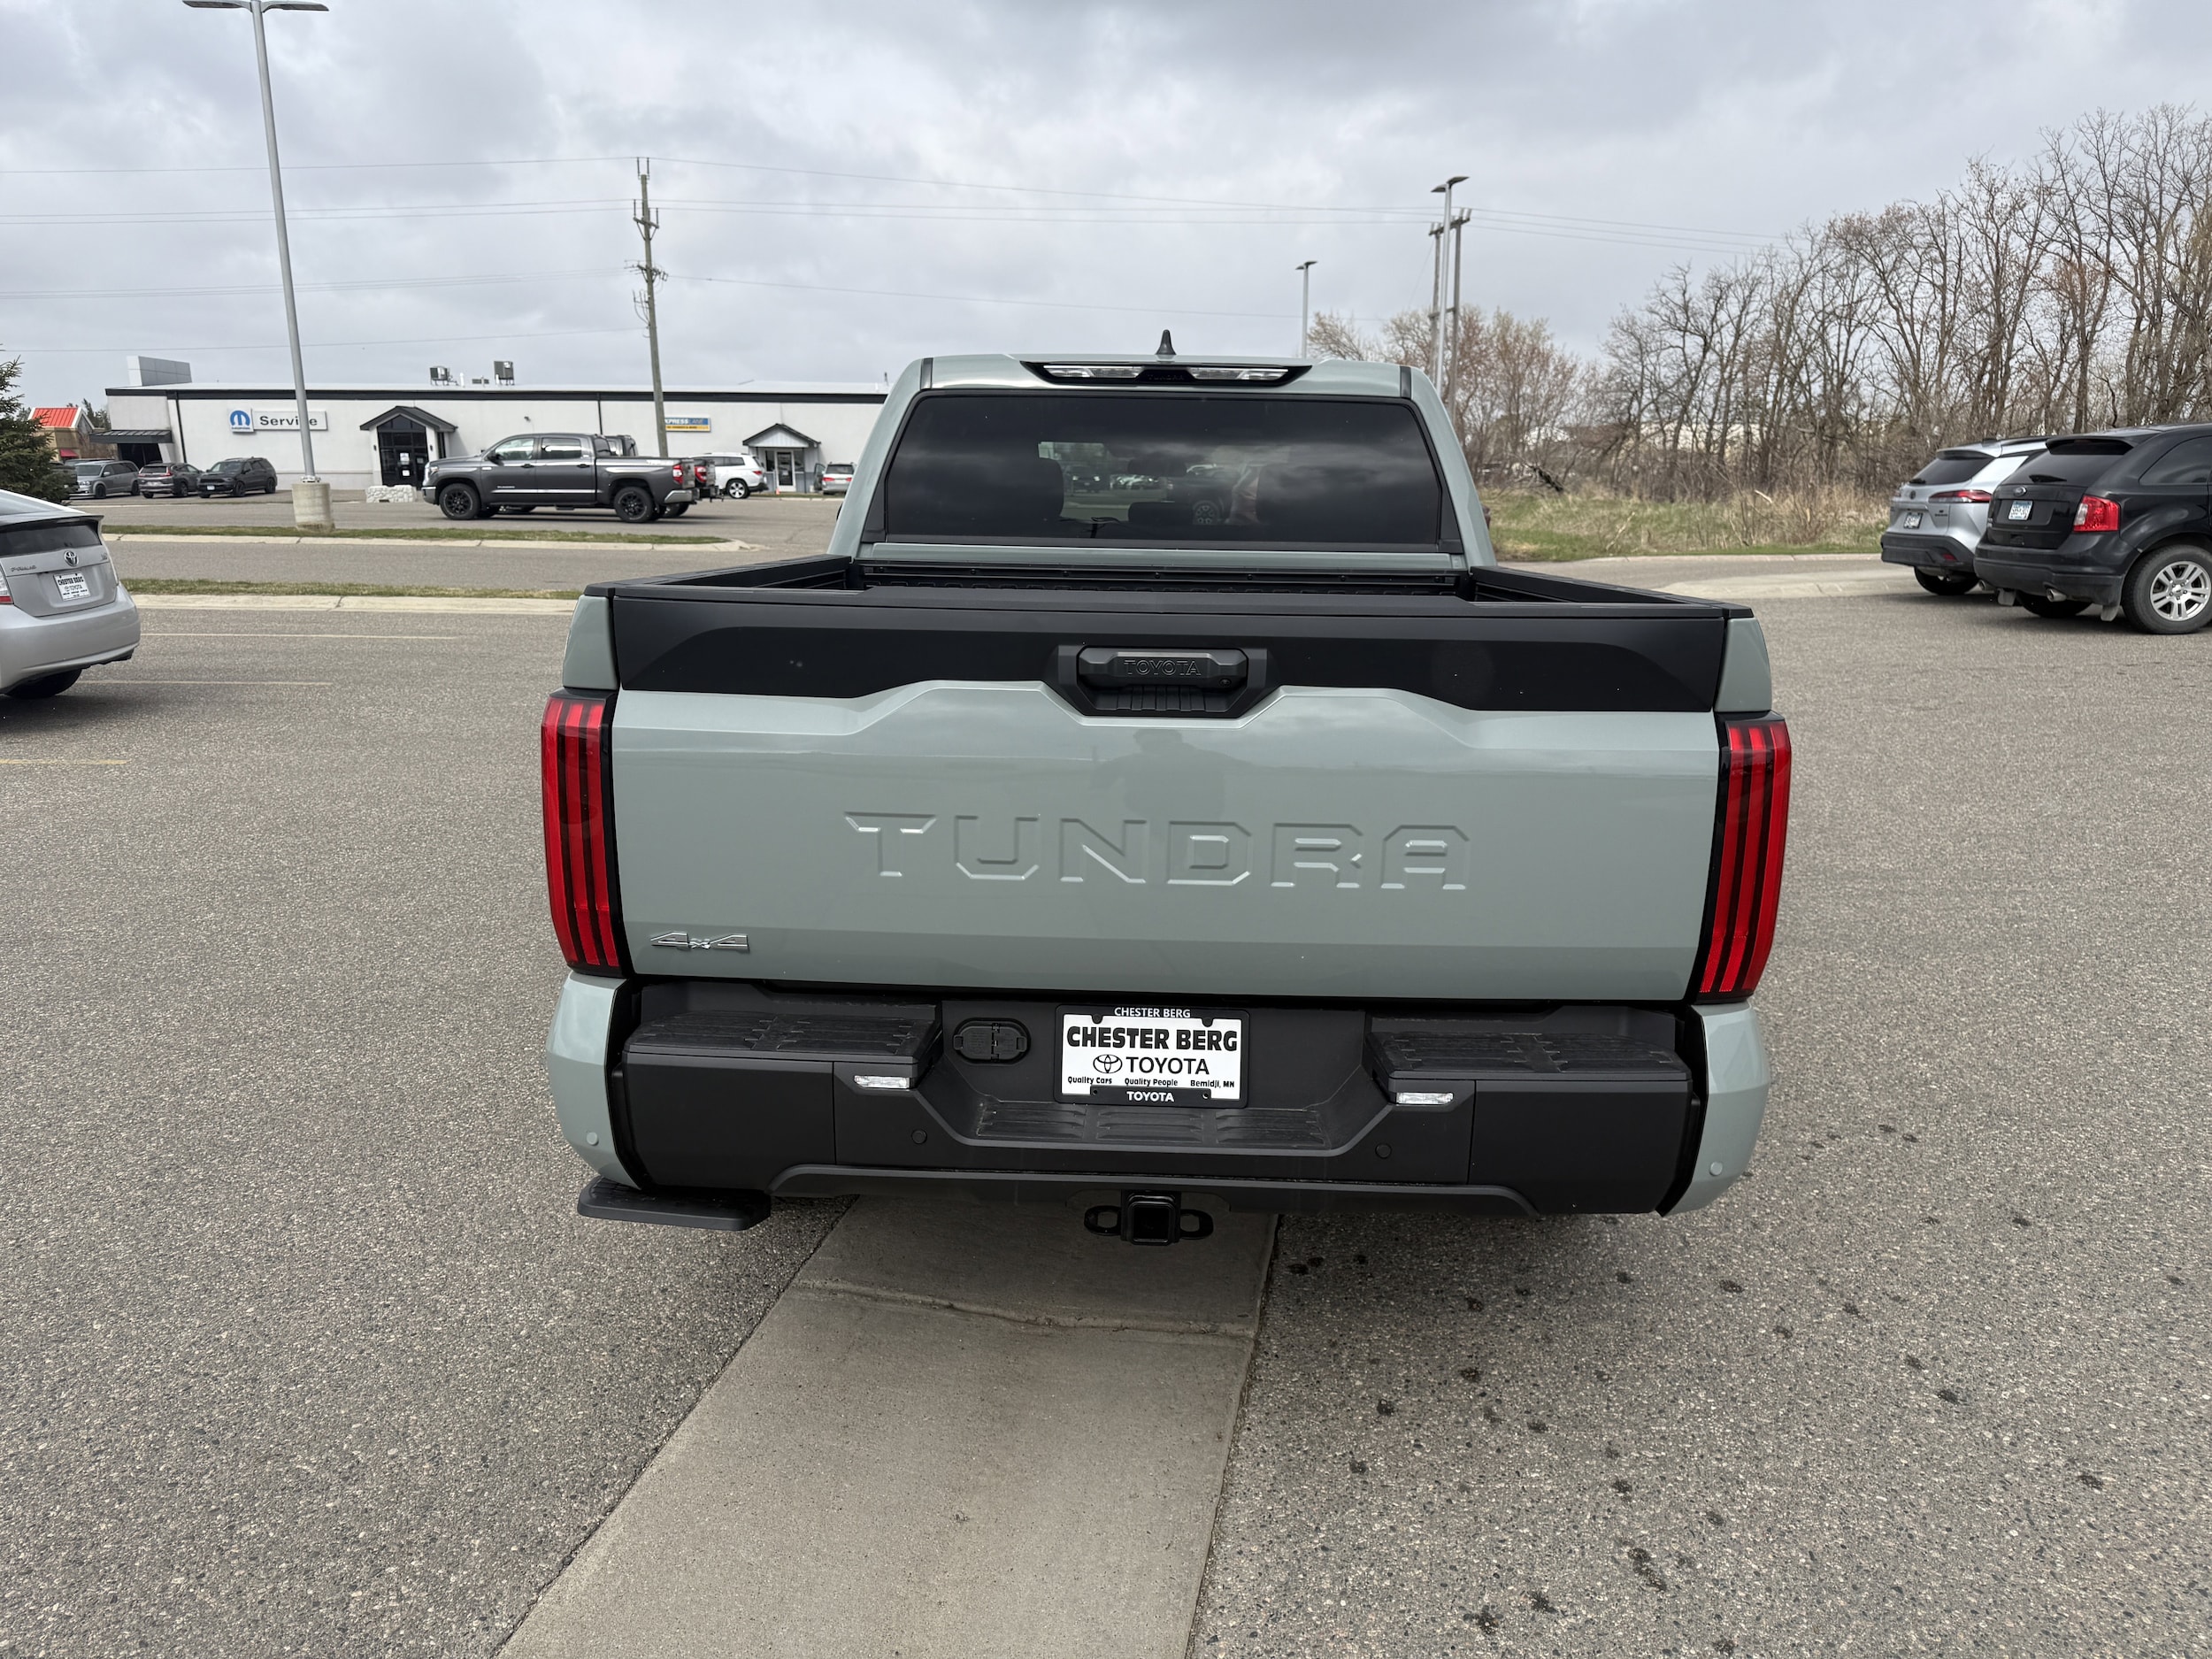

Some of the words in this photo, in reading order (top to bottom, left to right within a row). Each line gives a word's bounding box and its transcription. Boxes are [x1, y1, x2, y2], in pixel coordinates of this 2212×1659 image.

[259, 415, 318, 426] Servie
[1124, 658, 1202, 677] TOYOTA
[843, 810, 1471, 890] TUNDRA
[1114, 1007, 1160, 1018] CHESTER
[1163, 1008, 1191, 1018] BERG
[1066, 1025, 1170, 1049] CHESTER
[1176, 1029, 1238, 1051] BERG
[1125, 1056, 1210, 1075] TOYOTA
[1067, 1076, 1094, 1085] Quality
[1124, 1078, 1151, 1087] Quality
[1152, 1079, 1179, 1087] People
[1126, 1090, 1175, 1102] TOYOTA
